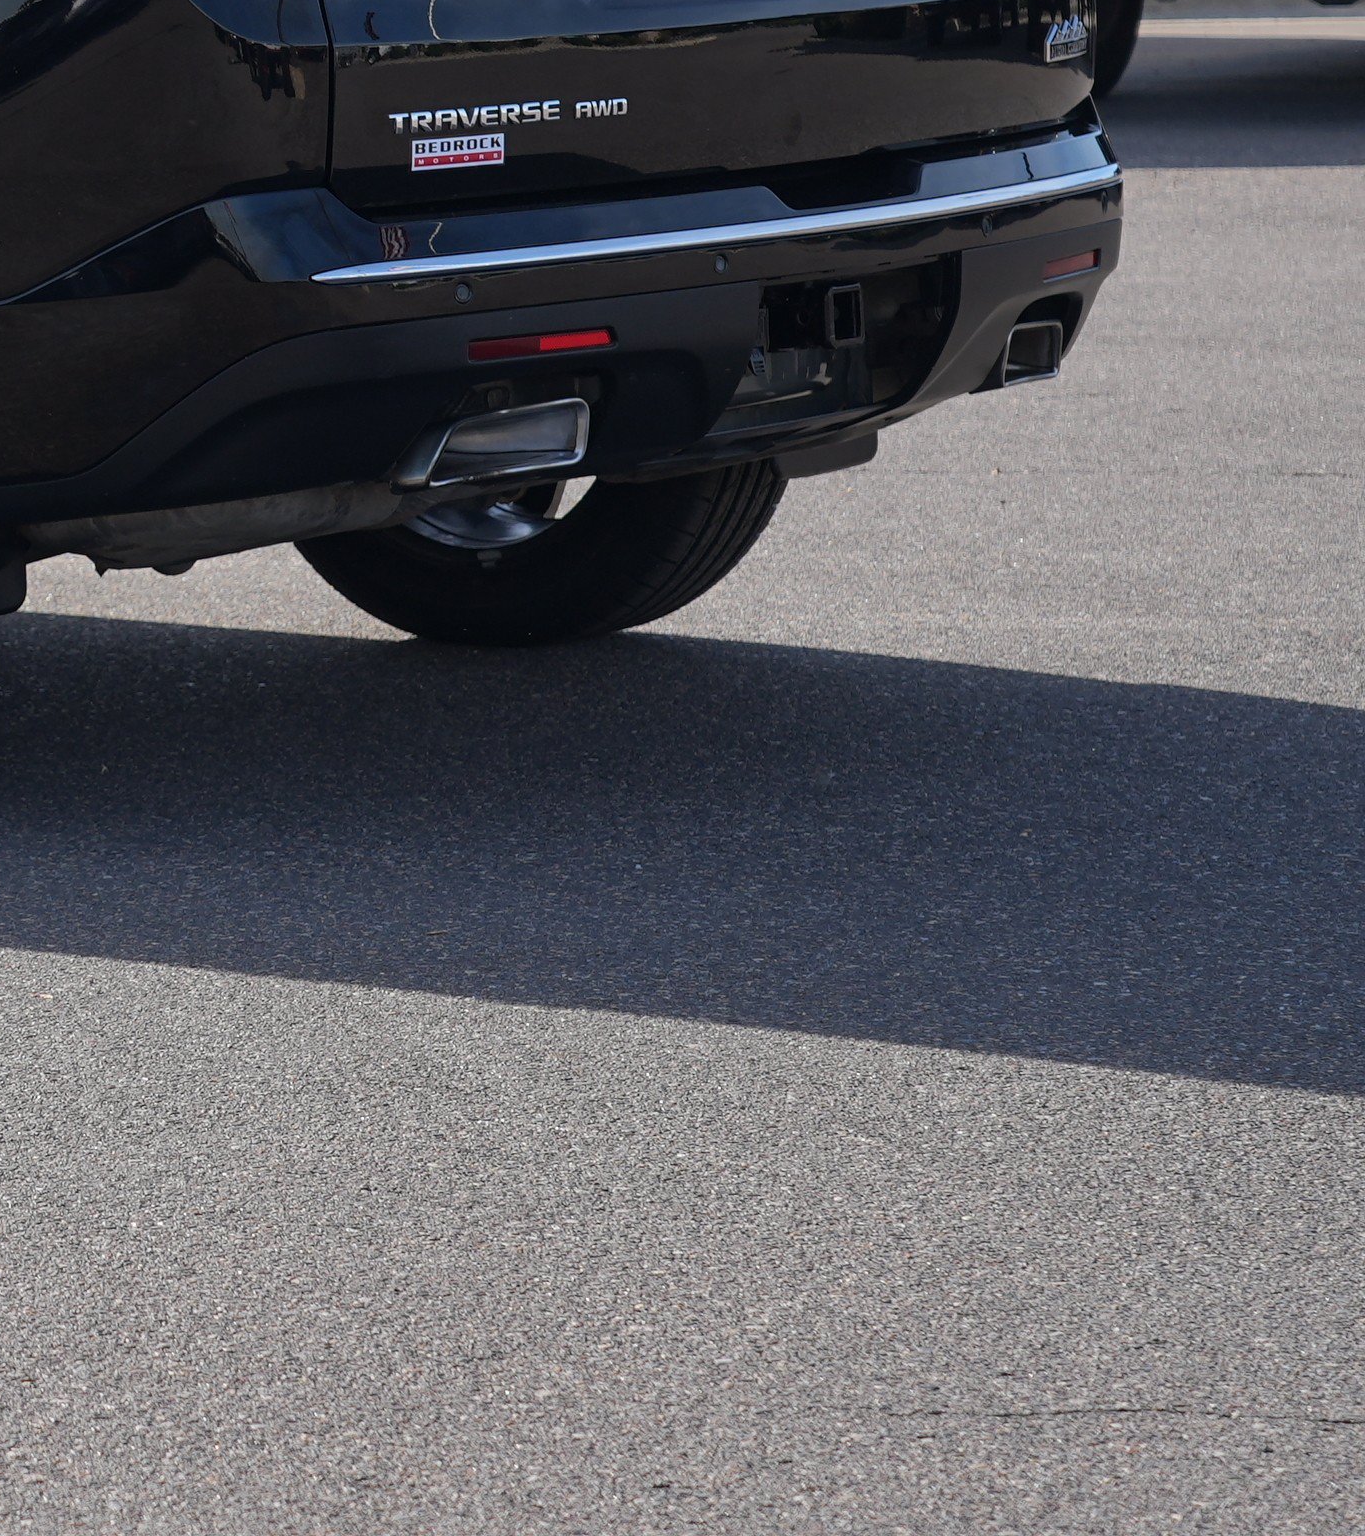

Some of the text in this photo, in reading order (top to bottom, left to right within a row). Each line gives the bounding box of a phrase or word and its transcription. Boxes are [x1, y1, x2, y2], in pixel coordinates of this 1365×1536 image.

[389, 98, 628, 134] TRAVERSE AWD
[414, 136, 502, 155] BEDROCK
[417, 152, 499, 165] MOTORS
